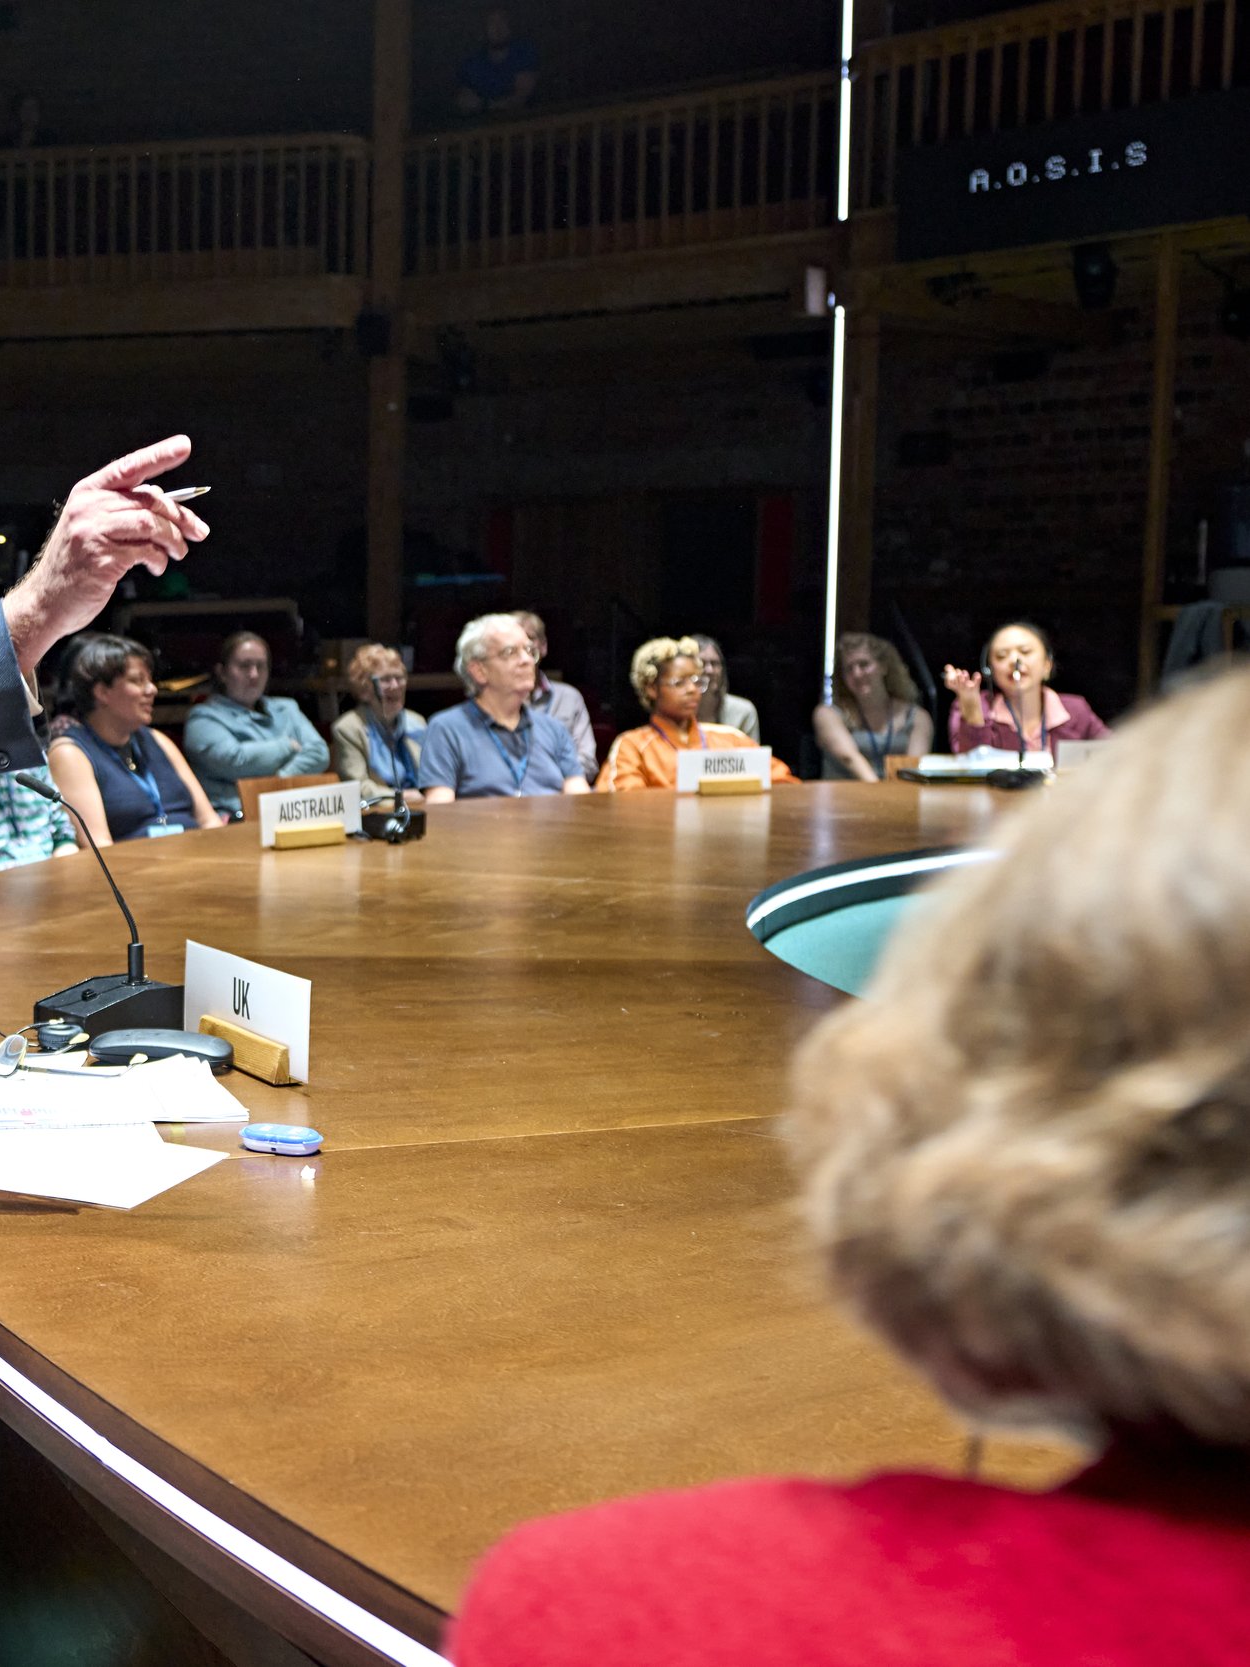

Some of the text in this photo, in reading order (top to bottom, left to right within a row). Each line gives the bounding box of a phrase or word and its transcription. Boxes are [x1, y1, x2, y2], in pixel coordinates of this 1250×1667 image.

[968, 140, 1148, 193] A.O.S.I.S
[704, 757, 746, 774] RUSSIA
[279, 793, 345, 822] AUSTRALIA
[233, 977, 250, 1020] UK
